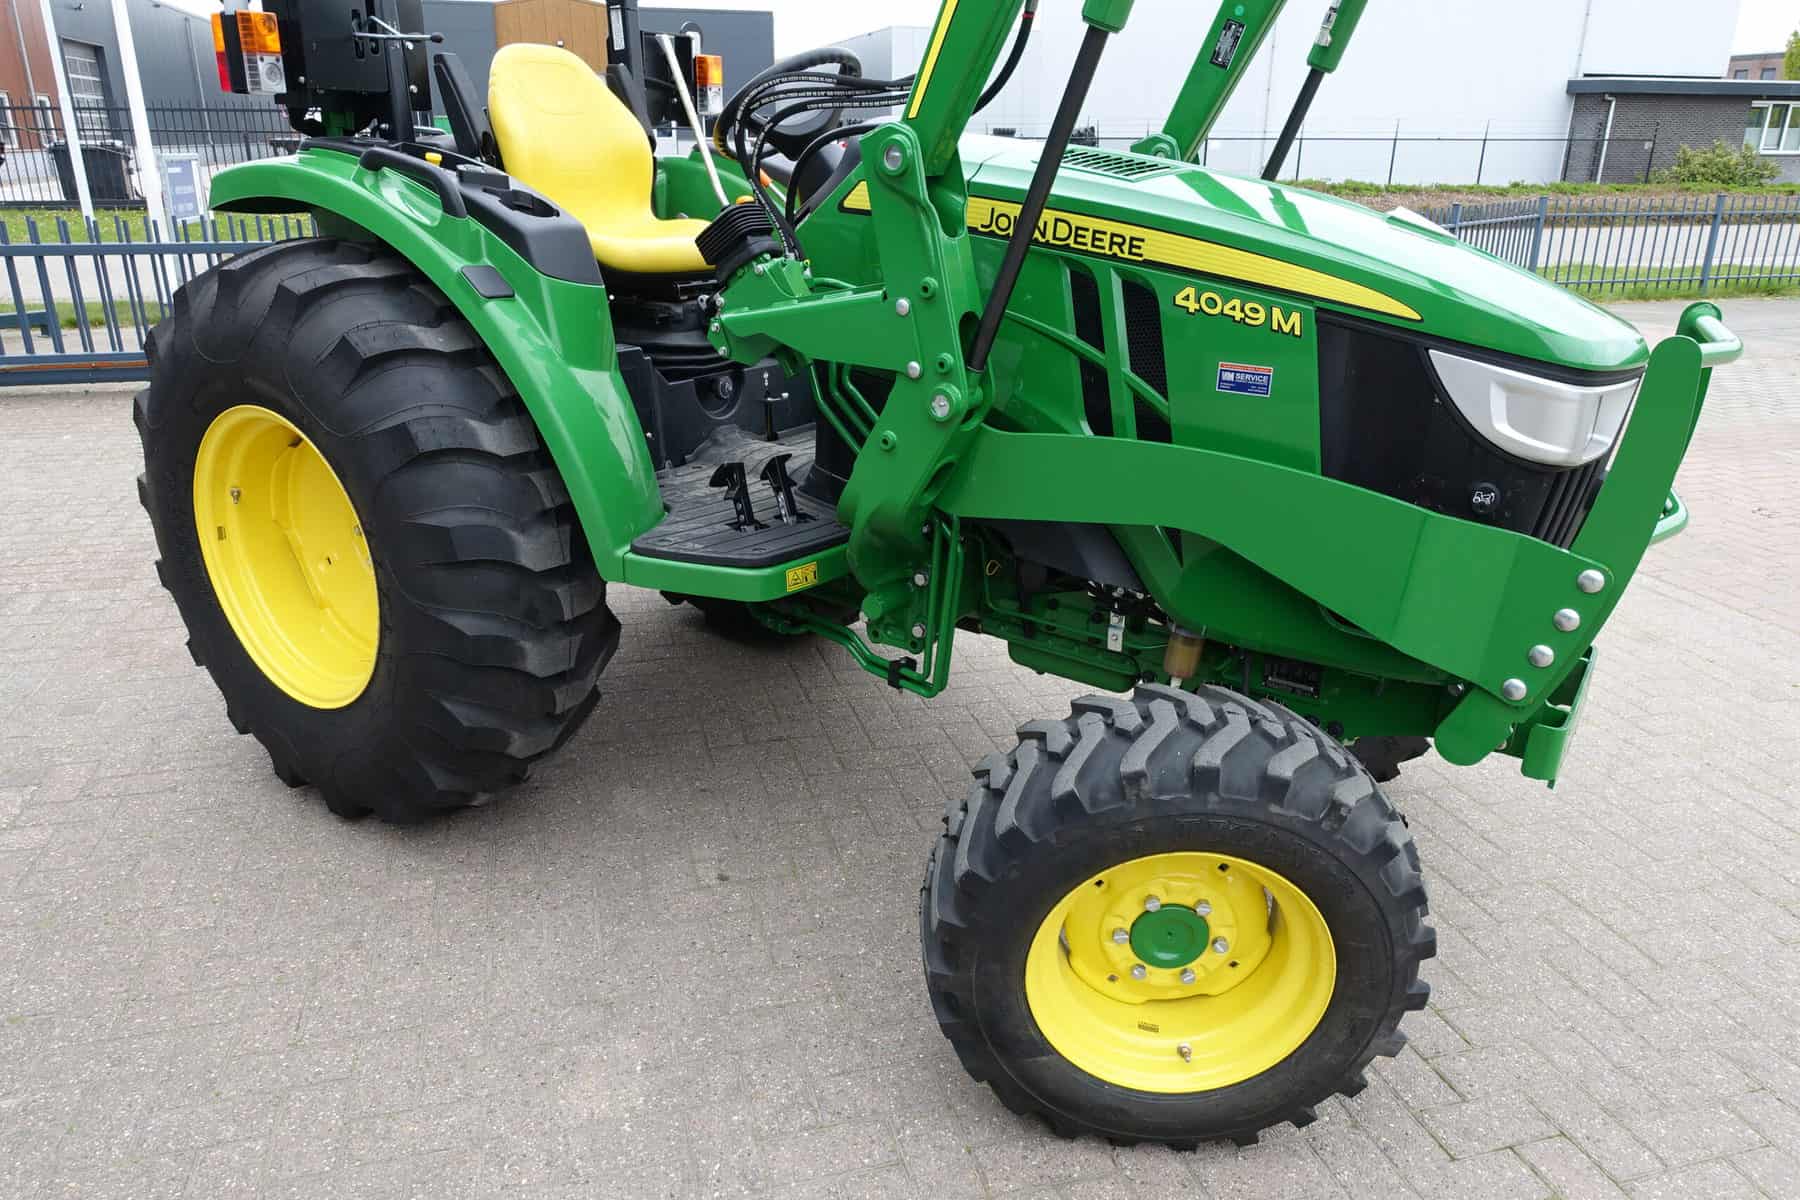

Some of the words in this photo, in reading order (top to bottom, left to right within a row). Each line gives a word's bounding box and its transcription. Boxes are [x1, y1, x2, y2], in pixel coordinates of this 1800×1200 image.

[1053, 217, 1145, 257] DEERE
[1174, 286, 1266, 327] 4049
[1271, 306, 1302, 337] M
[1235, 372, 1269, 384] SERVICE
